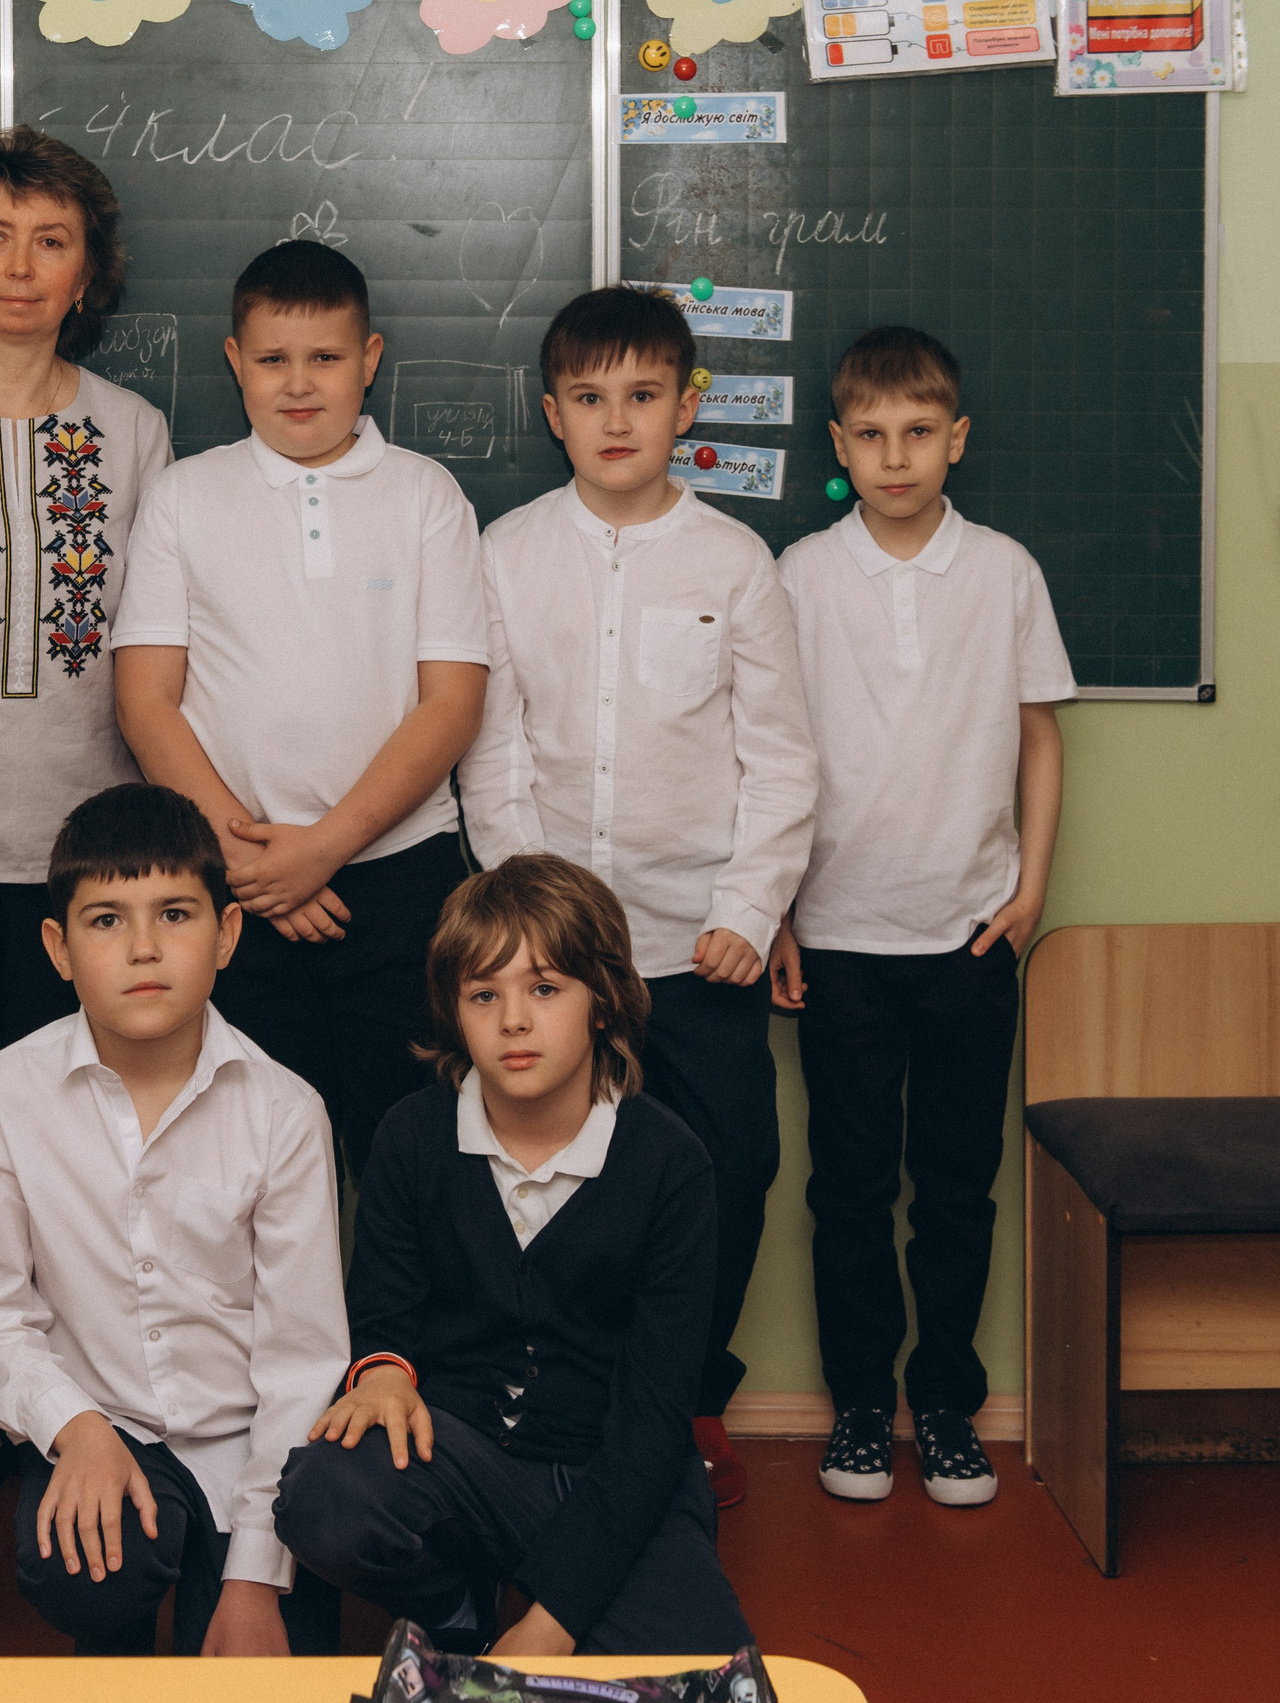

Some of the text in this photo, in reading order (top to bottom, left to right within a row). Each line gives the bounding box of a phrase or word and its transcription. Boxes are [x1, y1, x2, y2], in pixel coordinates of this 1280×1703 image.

[728, 110, 758, 124] світ
[680, 300, 766, 318] аїнська мова
[731, 394, 766, 405] мова
